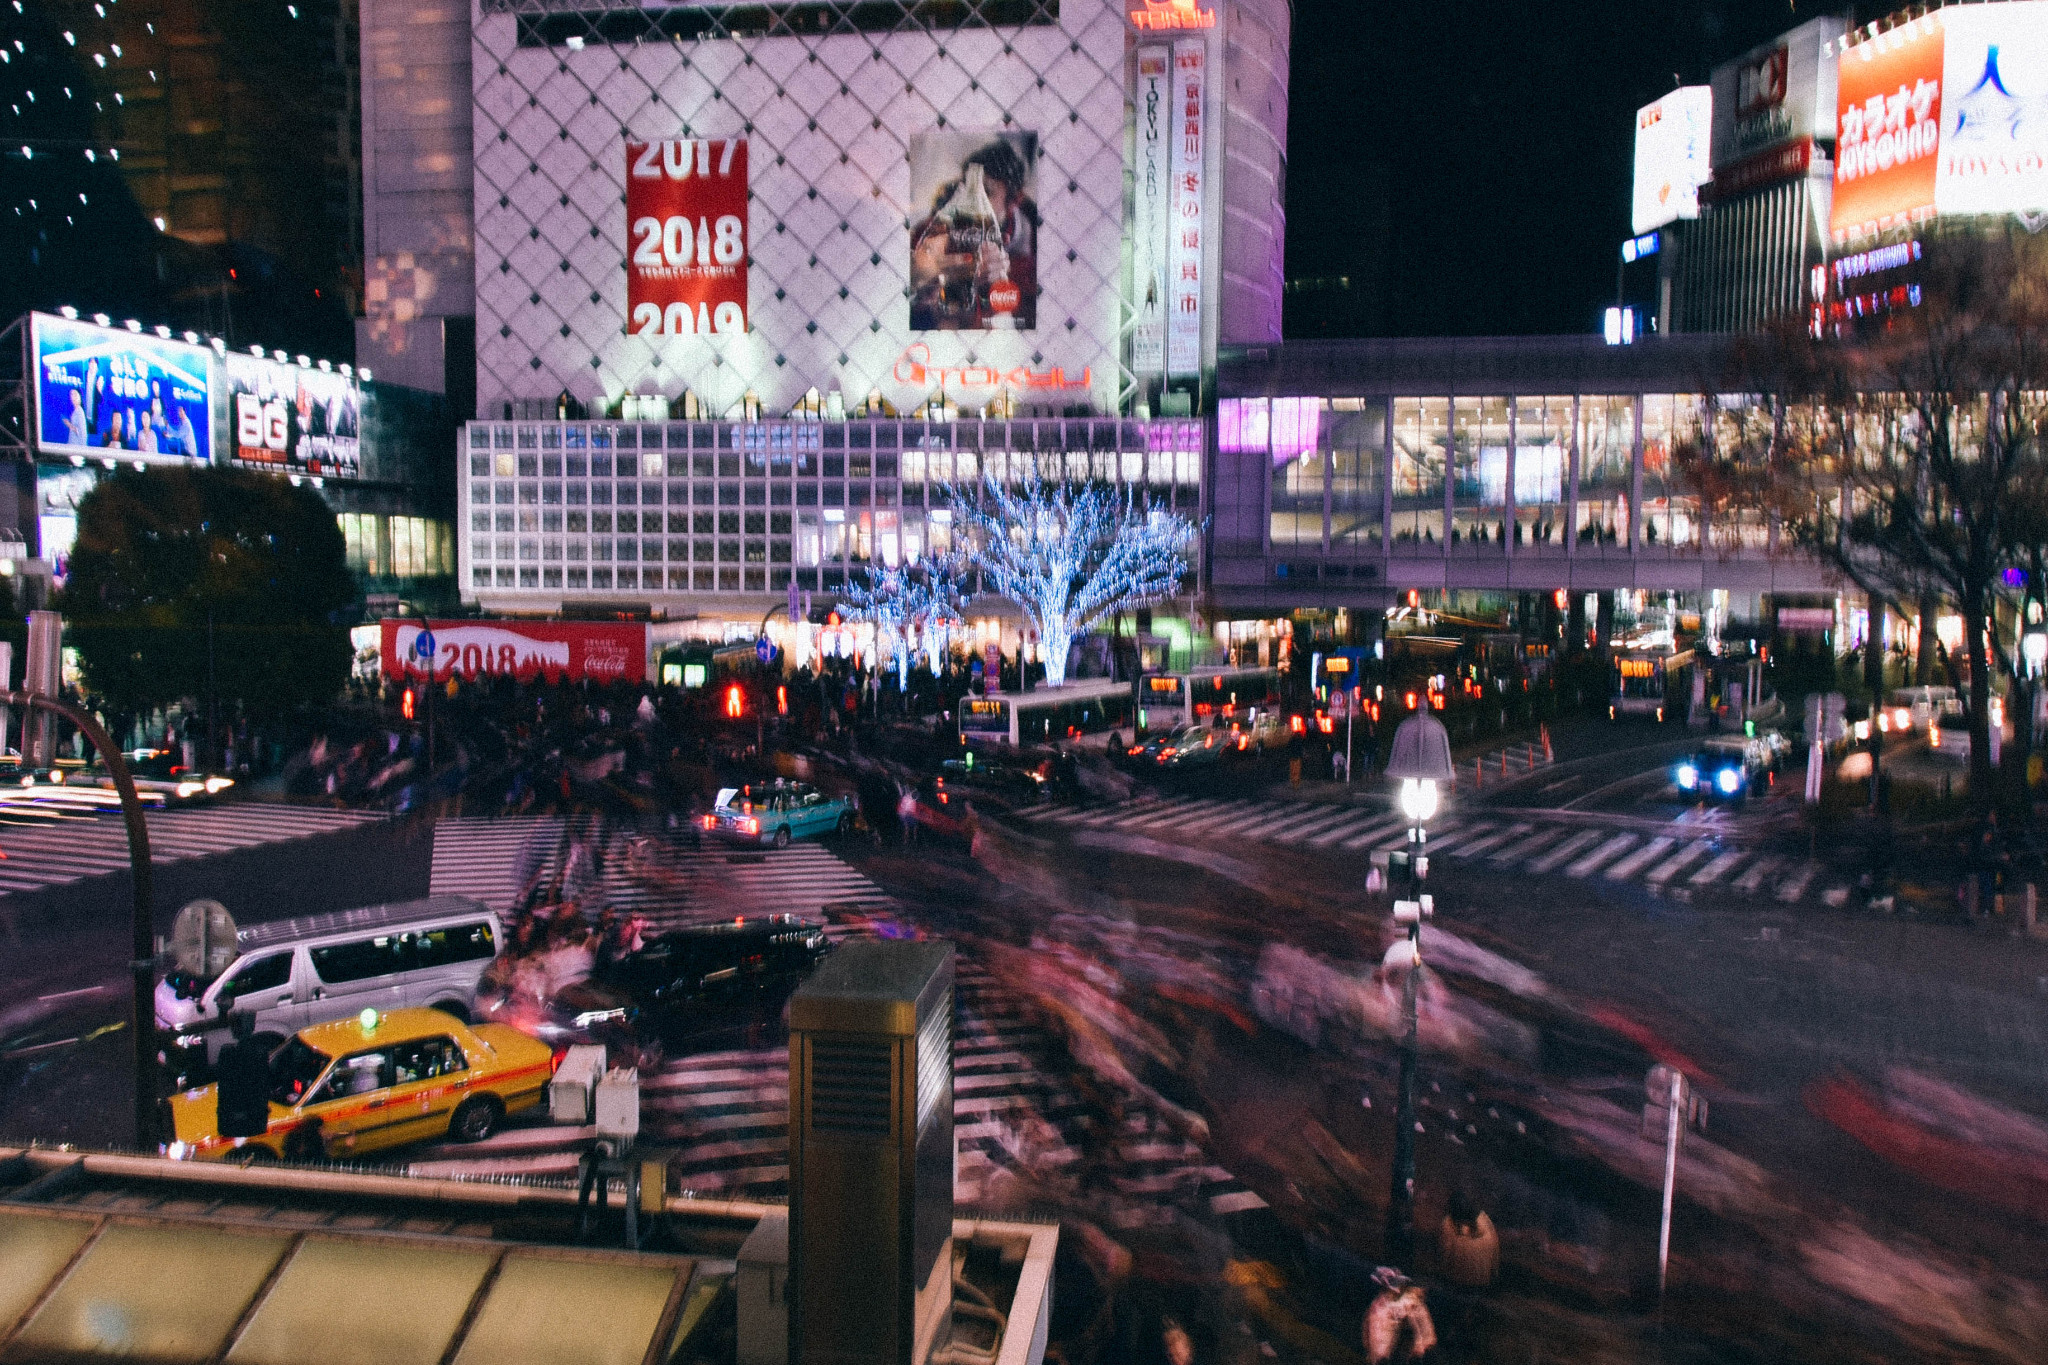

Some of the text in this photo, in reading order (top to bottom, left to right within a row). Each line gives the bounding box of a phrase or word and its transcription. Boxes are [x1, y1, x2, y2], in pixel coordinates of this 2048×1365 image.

[1146, 77, 1159, 141] TOKYU
[1840, 78, 1939, 148] カラオケ
[633, 138, 738, 180] 2017
[1145, 144, 1157, 197] CARD
[633, 215, 744, 267] 2018
[633, 301, 744, 334] 2019
[927, 367, 1091, 390] TOKYU
[441, 643, 517, 673] 2018
